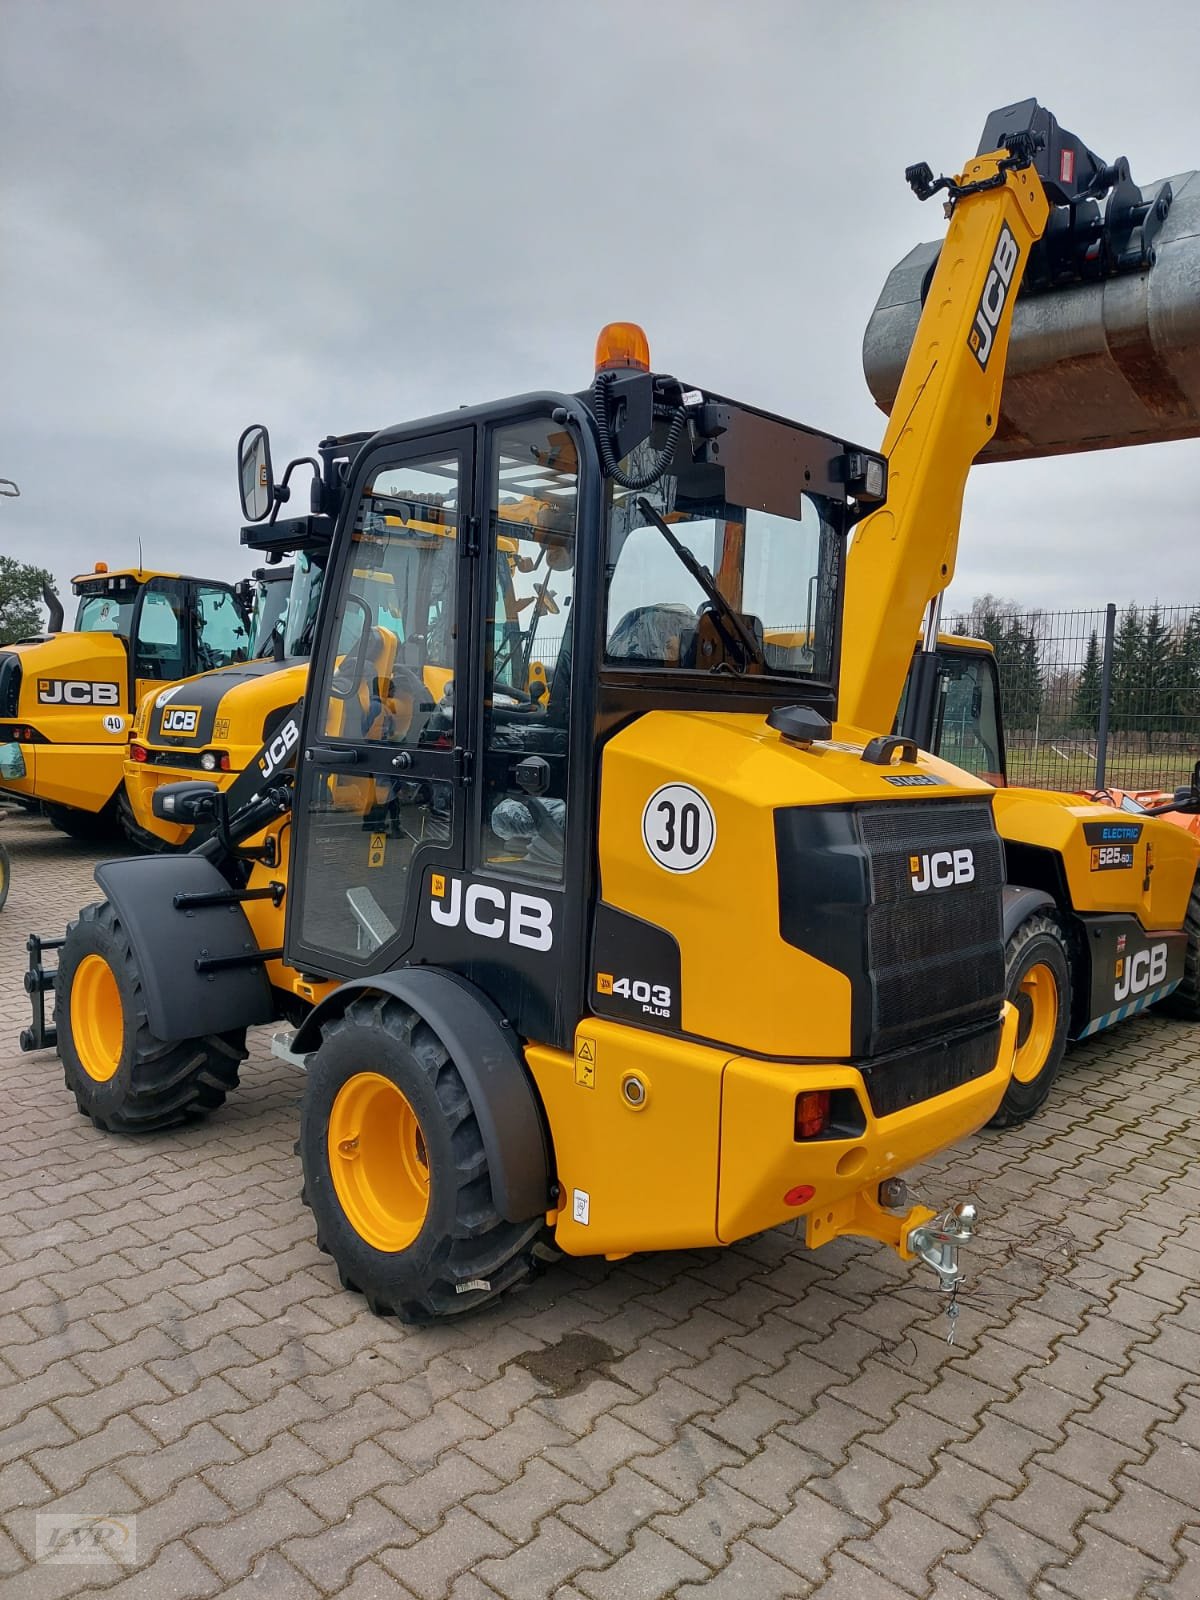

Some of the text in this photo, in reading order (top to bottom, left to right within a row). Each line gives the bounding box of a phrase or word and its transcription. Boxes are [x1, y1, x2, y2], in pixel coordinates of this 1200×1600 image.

[976, 228, 1018, 363] JCB
[40, 681, 118, 705] JCB
[107, 717, 121, 730] 40
[163, 711, 197, 730] JCB
[261, 719, 299, 778] JCB
[656, 800, 700, 855] 30
[1103, 828, 1139, 839] ELECTRIC
[911, 848, 975, 892] JCB
[430, 878, 553, 951] JCB
[1114, 943, 1168, 1001] JCB
[612, 977, 671, 1008] 403
[642, 1004, 671, 1018] PLUS
